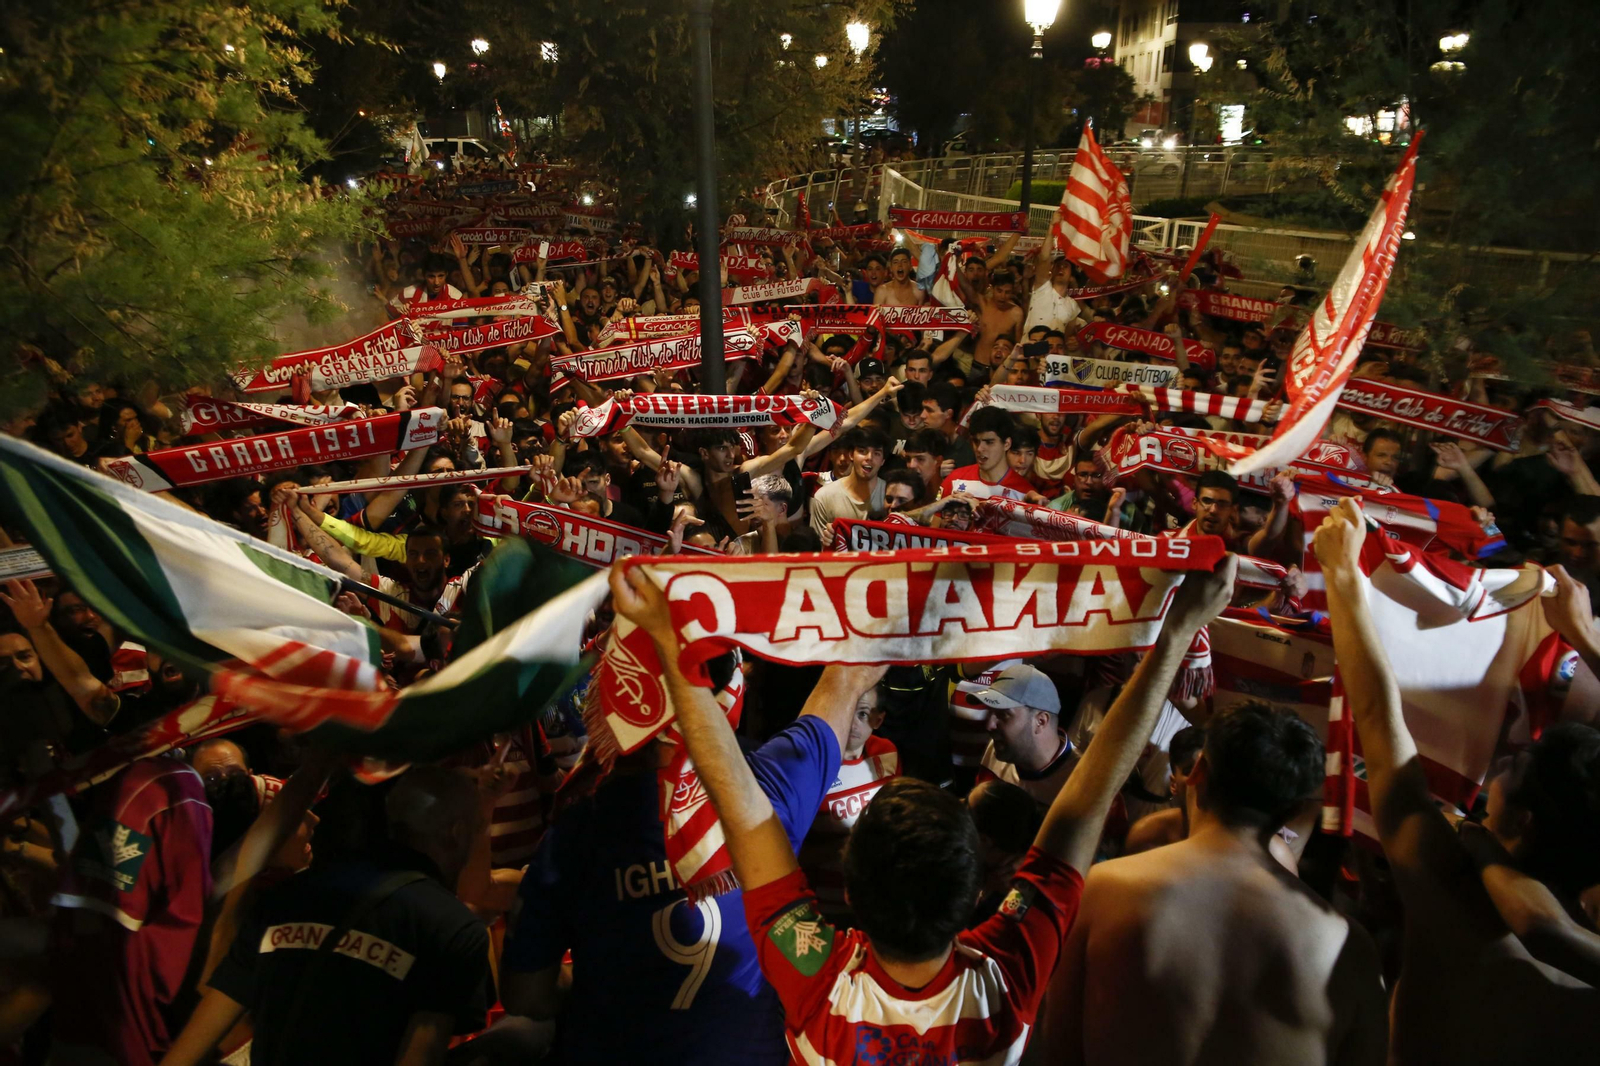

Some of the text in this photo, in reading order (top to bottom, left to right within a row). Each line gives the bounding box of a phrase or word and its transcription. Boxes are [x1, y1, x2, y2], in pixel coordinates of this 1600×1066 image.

[911, 212, 1002, 228] GRANADA C.F.
[811, 227, 852, 239] RANADA
[513, 245, 564, 260] RANDA
[742, 291, 761, 300] CLUB
[1209, 293, 1275, 314] GRANAD
[410, 302, 448, 313] ranada
[884, 306, 936, 325] de Fútbol
[1211, 305, 1234, 317] CLUB
[463, 329, 485, 345] Club
[487, 326, 501, 343] de
[503, 316, 535, 339] Fútbol
[363, 329, 402, 357] Fútbol
[319, 350, 408, 377] GRANADA
[576, 334, 702, 382] Granada Club de Fútb
[324, 374, 351, 386] CLUB
[355, 370, 370, 380] DE
[1095, 365, 1121, 381] CLUB
[1121, 367, 1132, 382] de
[1134, 365, 1172, 384] FÚTBOL
[618, 394, 788, 416] VOLVEREMOS
[989, 392, 1128, 405] ANADA ES DE PRIME
[635, 414, 771, 424] SEGUIREMOS HACIENDO HISTORIA
[1339, 387, 1392, 410] ranada
[1393, 397, 1424, 418] Club
[1424, 405, 1444, 424] de
[1444, 408, 1503, 438] Fútbol
[184, 421, 377, 474] GRADA 1931
[274, 458, 298, 468] CLUB
[1015, 538, 1192, 560] SOMOS
[1255, 630, 1293, 648] LEGEA
[615, 859, 677, 902] IGH
[367, 942, 403, 972] C.F.
[652, 895, 722, 1010] 9
